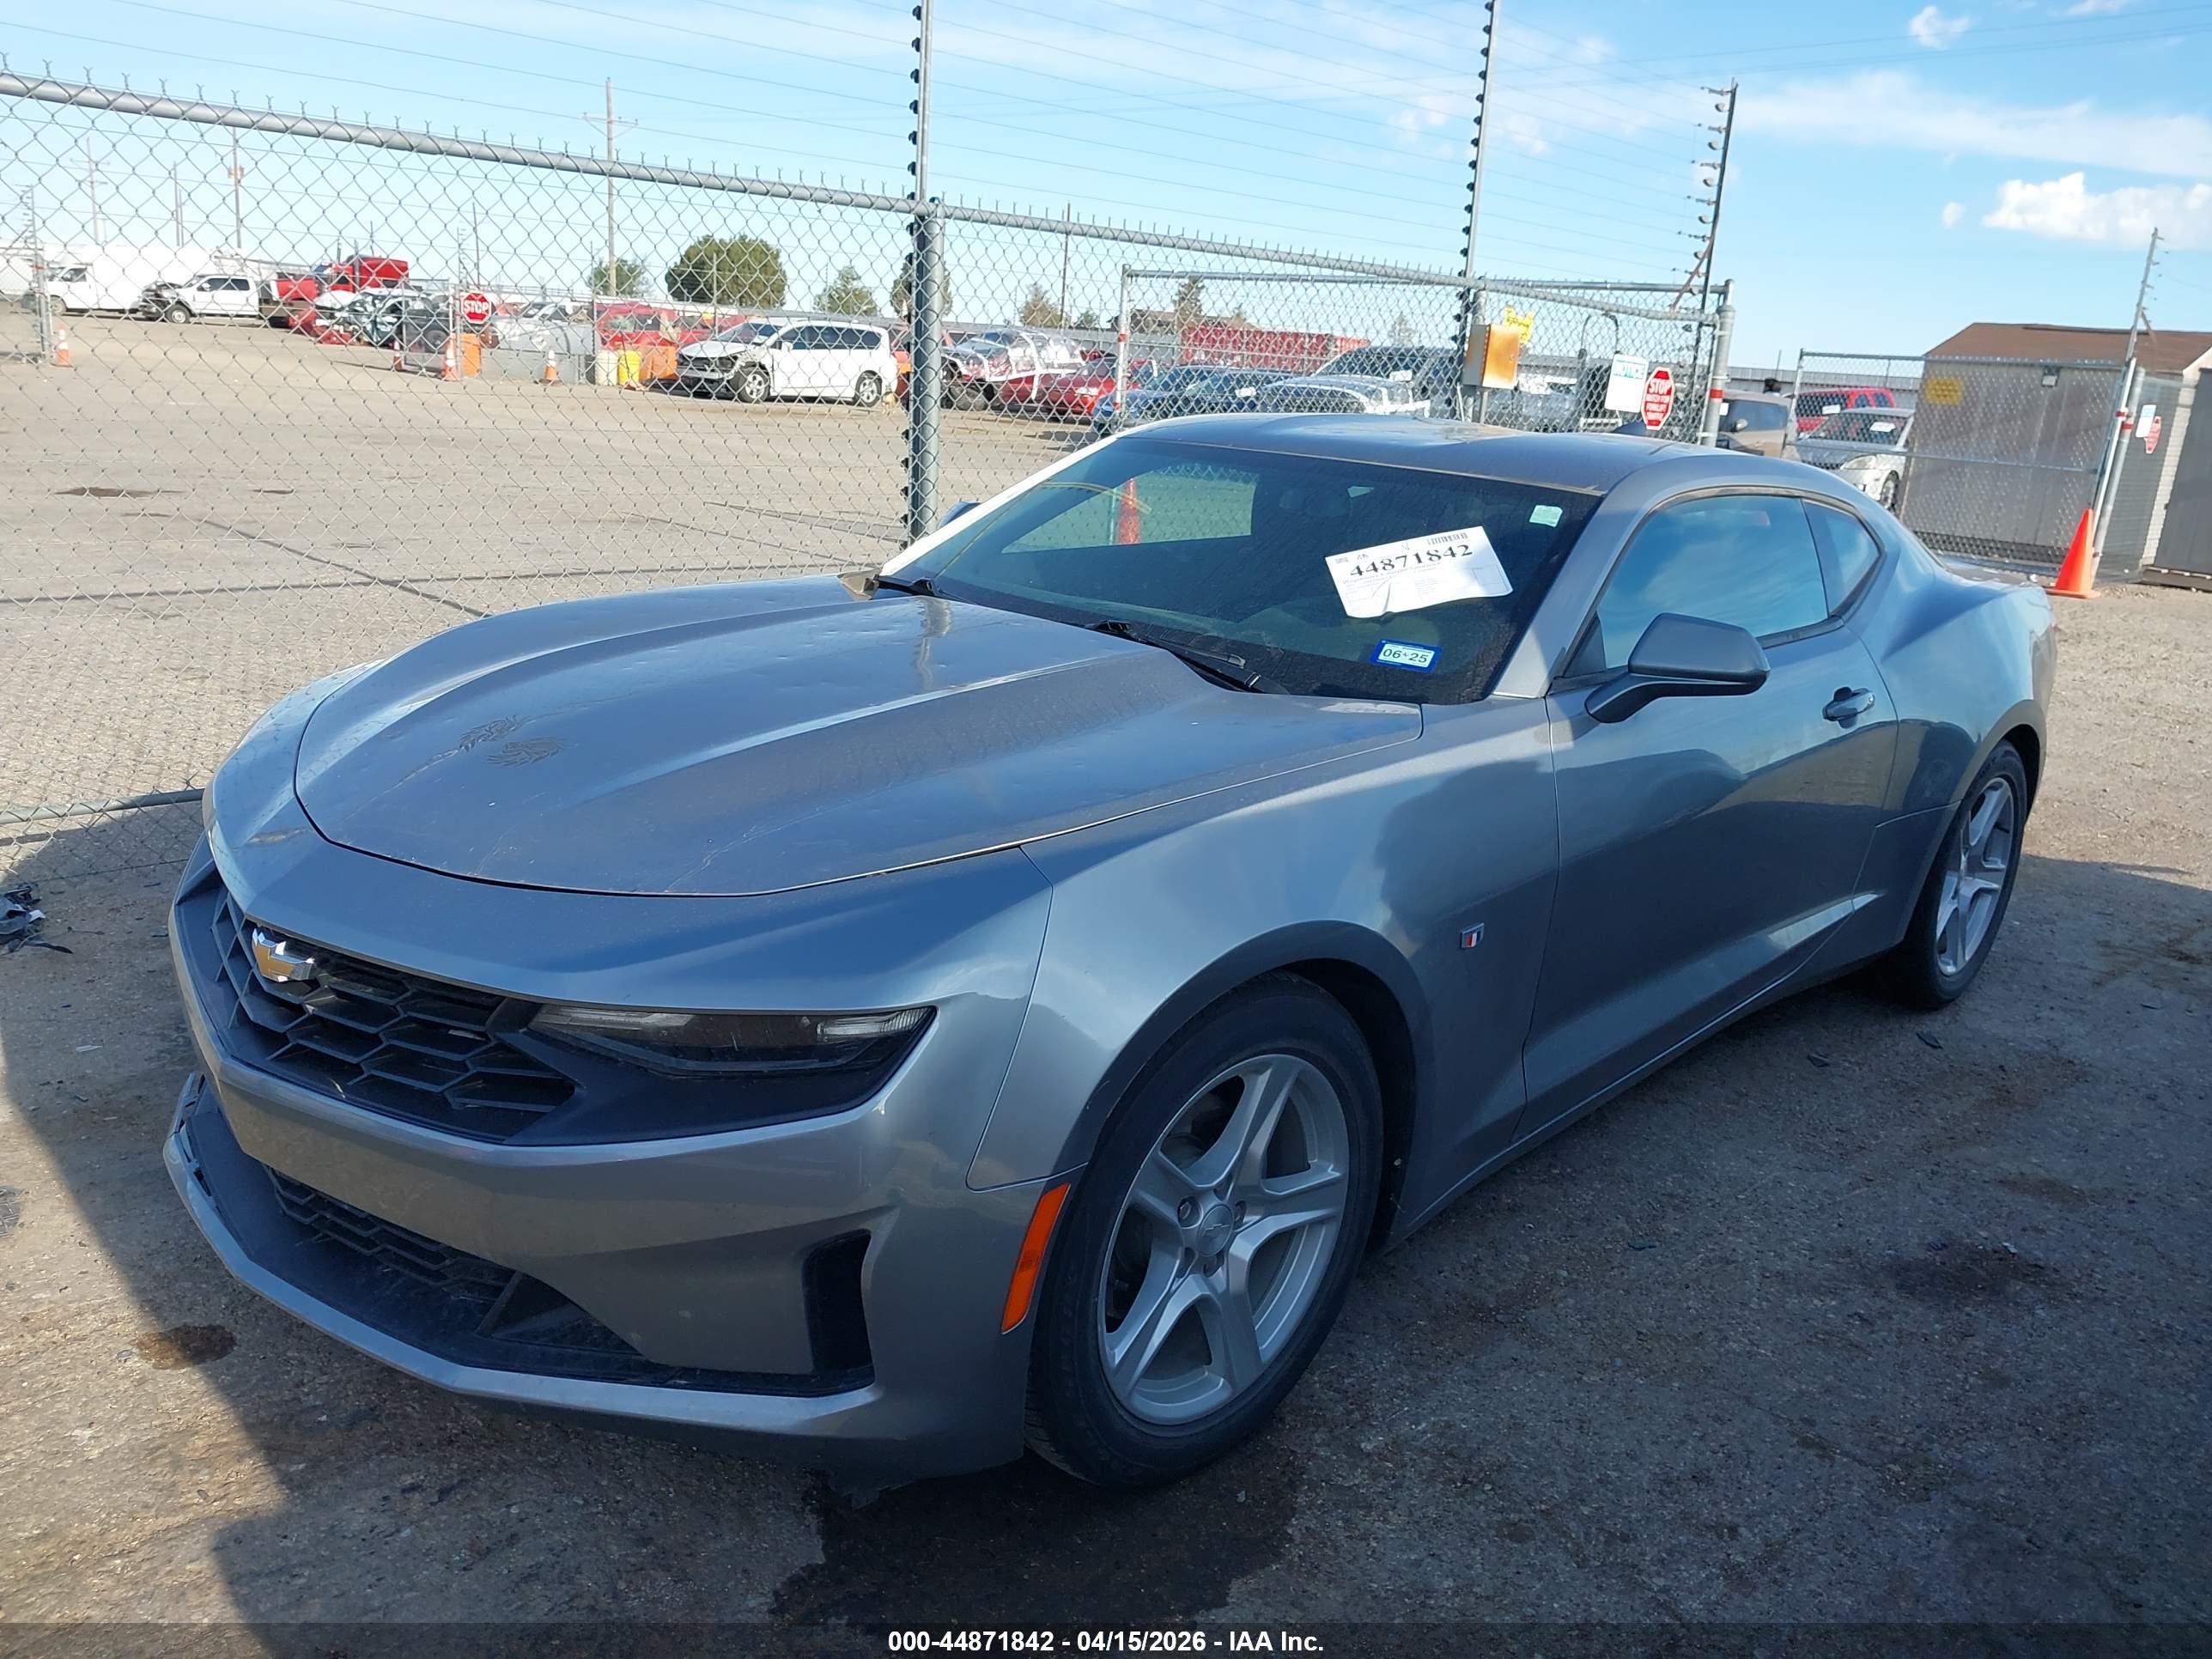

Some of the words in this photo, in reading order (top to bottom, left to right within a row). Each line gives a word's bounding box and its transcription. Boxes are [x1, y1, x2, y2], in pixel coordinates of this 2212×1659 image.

[464, 299, 489, 313] STOP
[1649, 379, 1672, 395] STOP
[1350, 544, 1473, 576] 44871842
